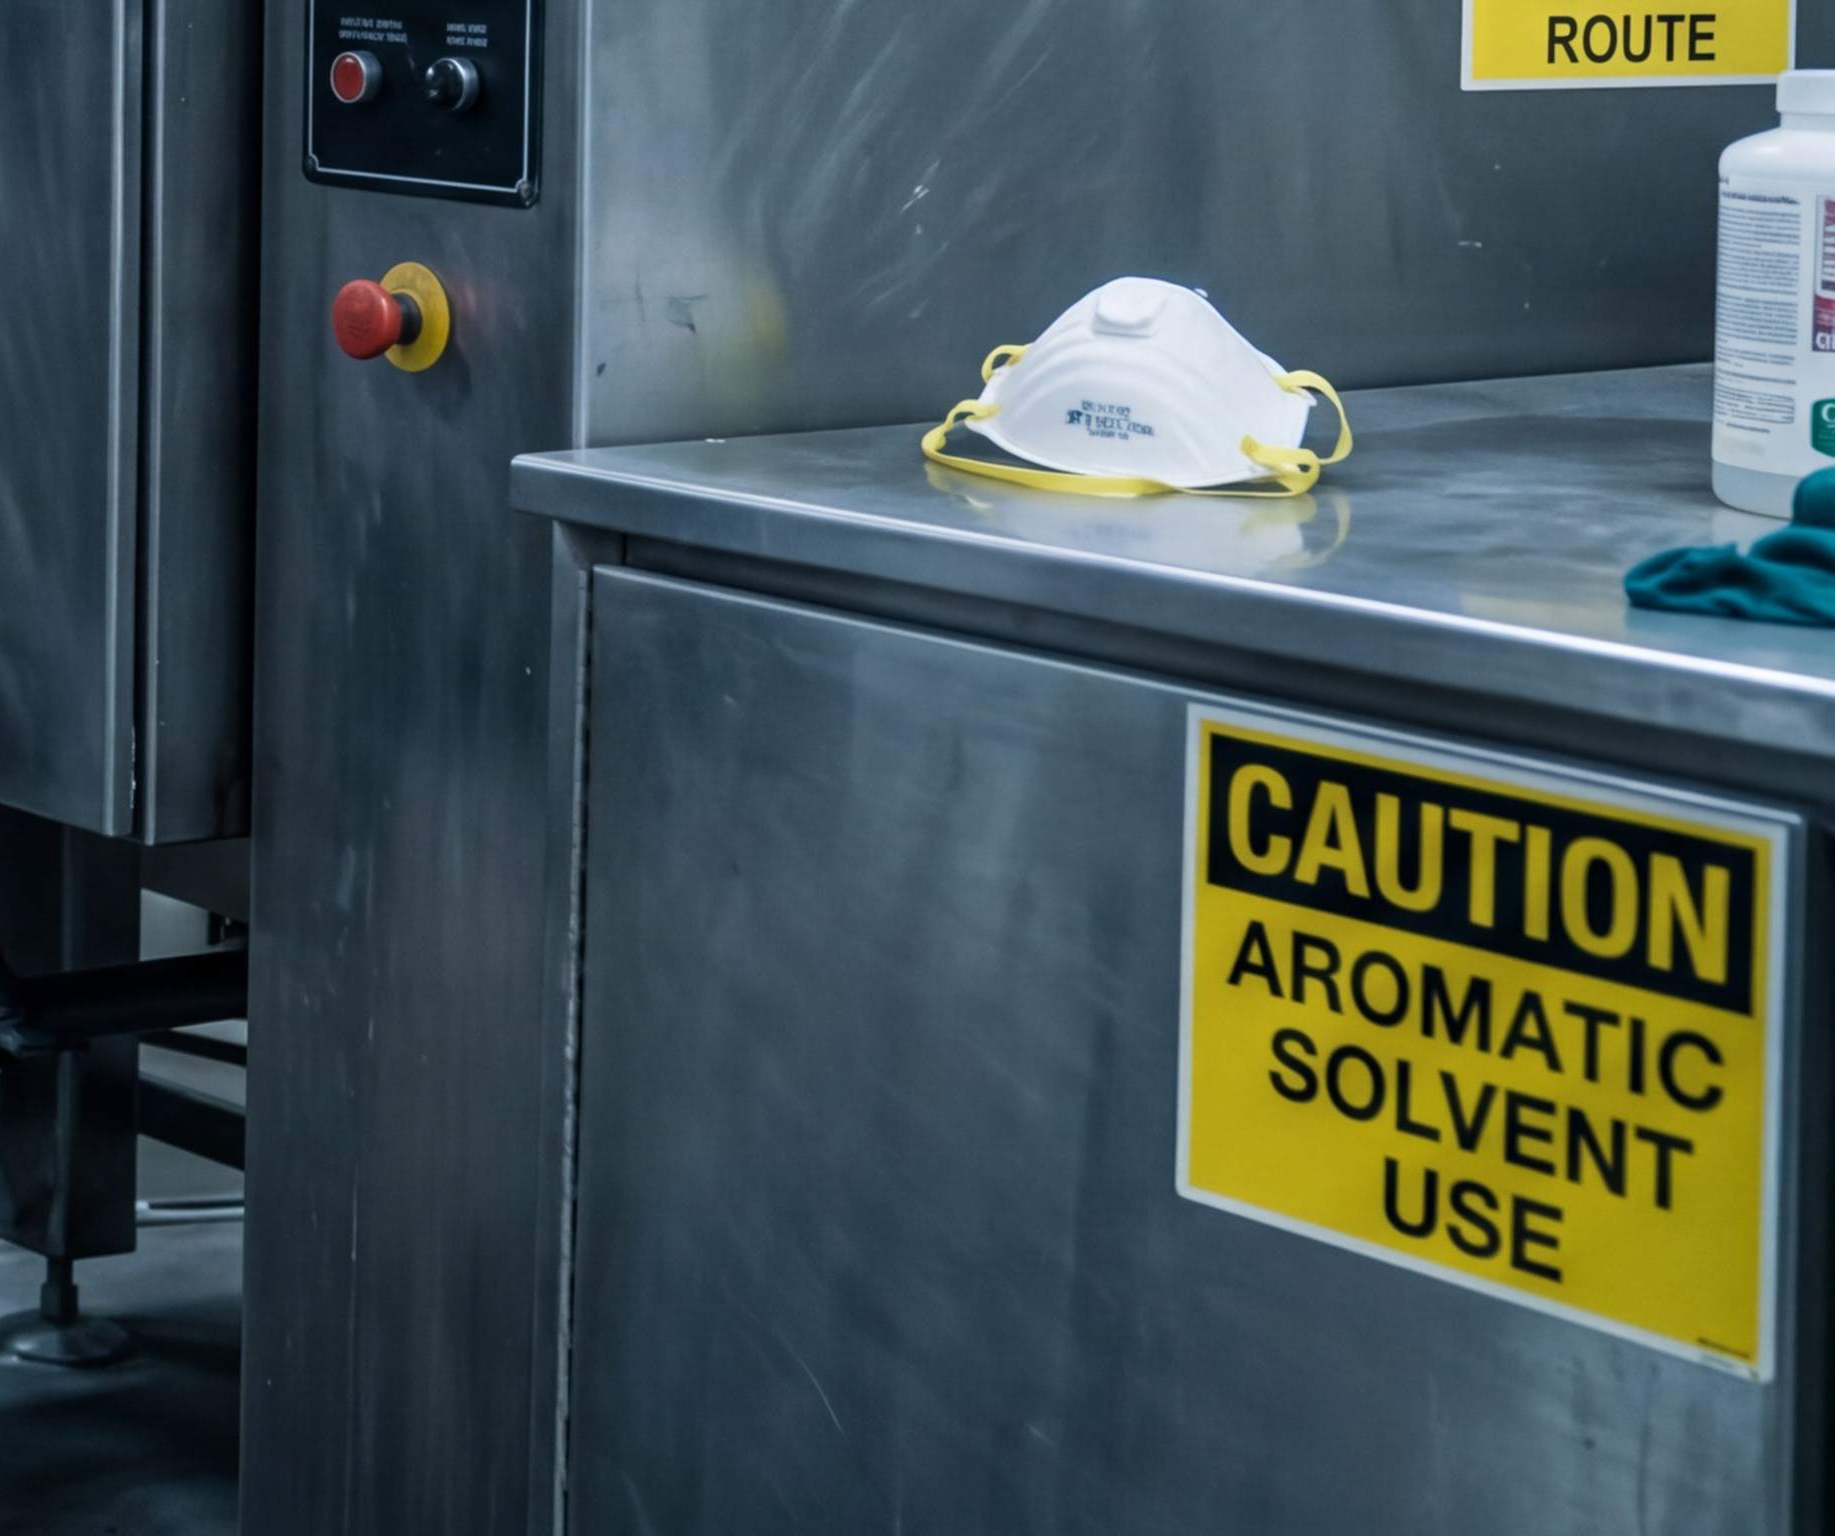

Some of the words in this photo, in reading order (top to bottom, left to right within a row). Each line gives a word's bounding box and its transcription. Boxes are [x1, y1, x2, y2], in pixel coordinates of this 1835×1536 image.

[1546, 14, 1717, 64] ROUTE
[1226, 763, 1731, 986] CAUTION
[1226, 919, 1726, 1114] AROMATIC
[1267, 1027, 1696, 1212] SOLVENT
[1382, 1156, 1565, 1285] USE
